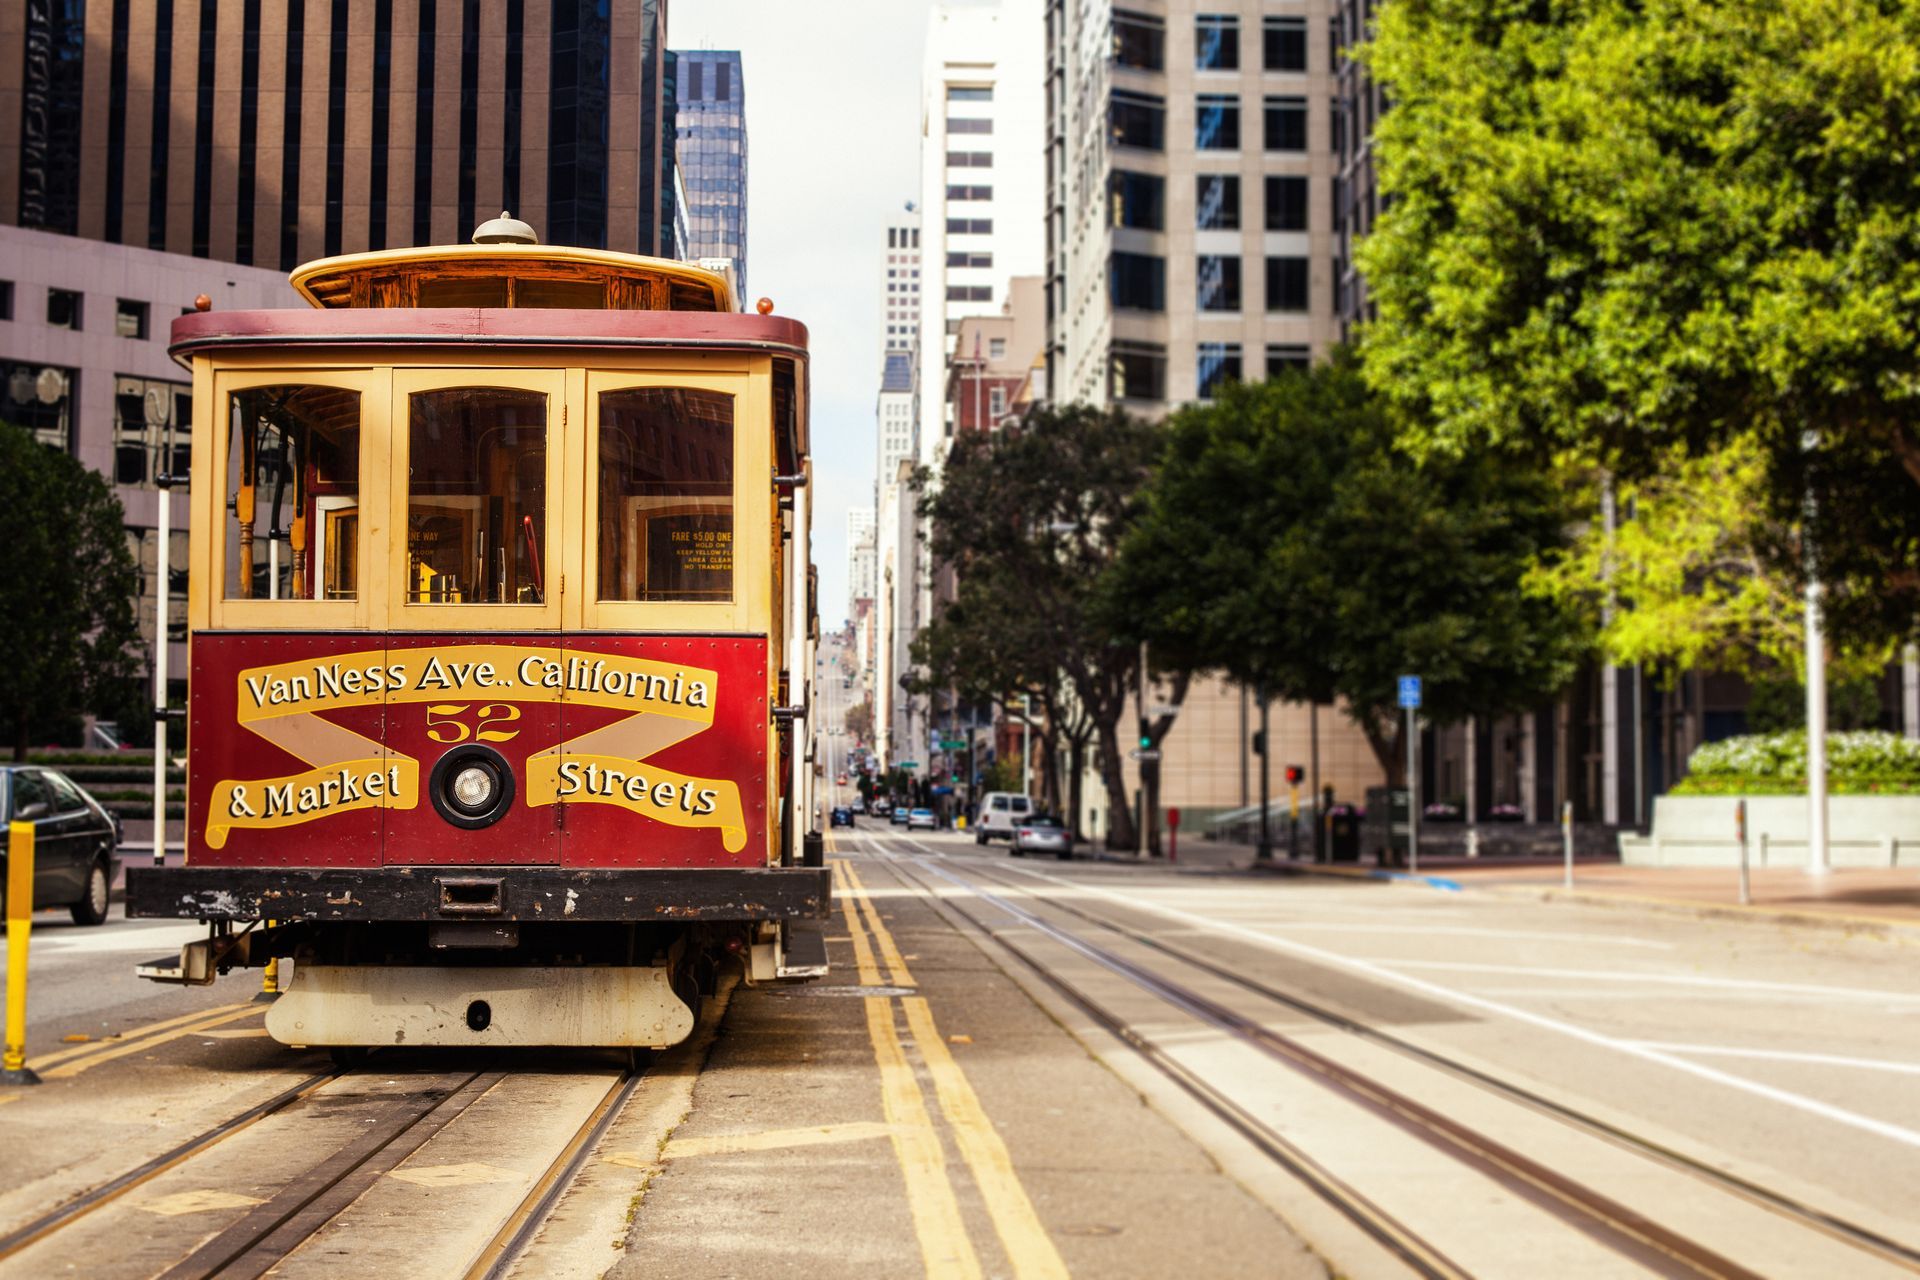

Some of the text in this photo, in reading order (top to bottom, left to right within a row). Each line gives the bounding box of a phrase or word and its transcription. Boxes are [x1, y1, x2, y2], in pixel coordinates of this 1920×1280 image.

[672, 532, 690, 541] FARE
[717, 532, 731, 542] ONE
[246, 674, 311, 707] Van
[315, 663, 407, 698] Ness
[518, 655, 708, 708] California
[426, 703, 521, 743] 52
[229, 761, 718, 818] & Market Streets
